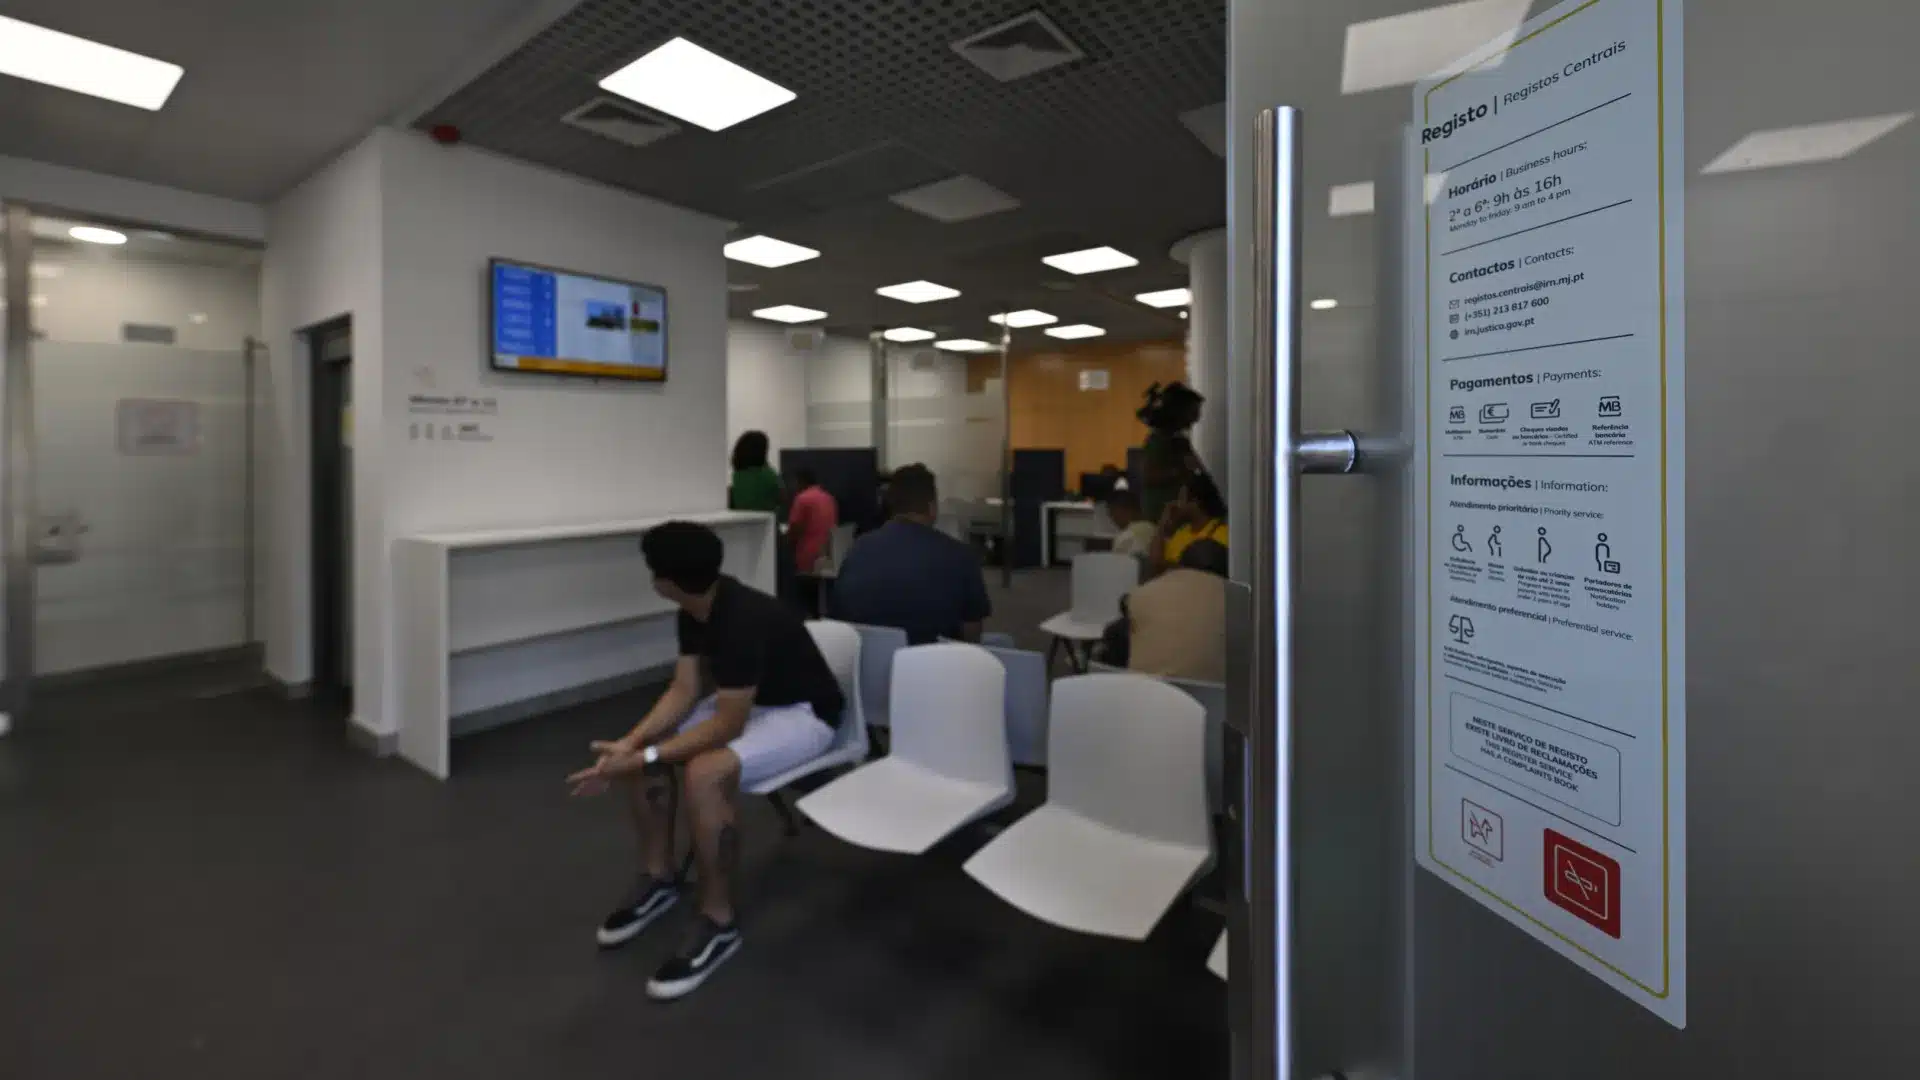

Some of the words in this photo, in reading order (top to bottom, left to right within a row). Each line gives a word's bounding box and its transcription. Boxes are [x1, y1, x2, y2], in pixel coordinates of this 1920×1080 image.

[1421, 104, 1488, 145] Registo
[1503, 73, 1560, 106] Registos
[1563, 40, 1627, 77] Centrais
[1448, 173, 1497, 199] Horário
[1505, 156, 1550, 178] Business
[1553, 141, 1588, 160] hours:
[1449, 217, 1478, 232] Monday
[1514, 204, 1520, 213] 9
[1521, 200, 1536, 209] am
[1537, 196, 1546, 205] to
[1548, 193, 1554, 201] 4
[1556, 188, 1571, 200] pm
[1463, 207, 1471, 218] a
[1493, 192, 1510, 208] 9h
[1513, 186, 1530, 200] às
[1534, 174, 1562, 193] 16h
[1449, 260, 1515, 283] Contactos
[1524, 246, 1575, 266] Contacts:
[1464, 272, 1585, 304] registos.centrais@irn.mj.pt
[1464, 308, 1491, 321] (+351)
[1493, 304, 1510, 315] 213
[1511, 300, 1529, 312] 817
[1531, 296, 1550, 307] 600
[1450, 373, 1534, 392] Pagamentos
[1543, 368, 1602, 383] Payments:
[1450, 410, 1465, 419] MB
[1598, 401, 1622, 413] MB
[1450, 474, 1532, 490] Informações
[1540, 480, 1608, 492] Information:
[1449, 500, 1497, 511] Atendimento
[1498, 502, 1539, 515] prioritário
[1544, 507, 1571, 517] Priority
[1572, 510, 1604, 520] service:
[1584, 577, 1622, 588] Portadores
[1590, 593, 1626, 604] Notification
[1449, 595, 1497, 611] Atendimento
[1498, 605, 1547, 623] preferencial
[1552, 616, 1600, 633] Preferential
[1600, 628, 1634, 641] service:
[1465, 722, 1490, 738] EXISTE
[1492, 732, 1516, 747] LIVRO
[1517, 742, 1528, 753] DE
[1530, 747, 1598, 780] RECLAMAÇÕES
[1472, 716, 1496, 731] NESTE
[1498, 724, 1533, 744] SERVIÇO
[1535, 739, 1547, 749] DE
[1549, 744, 1588, 765] REGISTO
[1502, 746, 1538, 765] REGISTER
[1539, 761, 1574, 781] SERVICE
[1503, 755, 1553, 782] COMPLAINTS
[1554, 776, 1580, 793] BOOK
